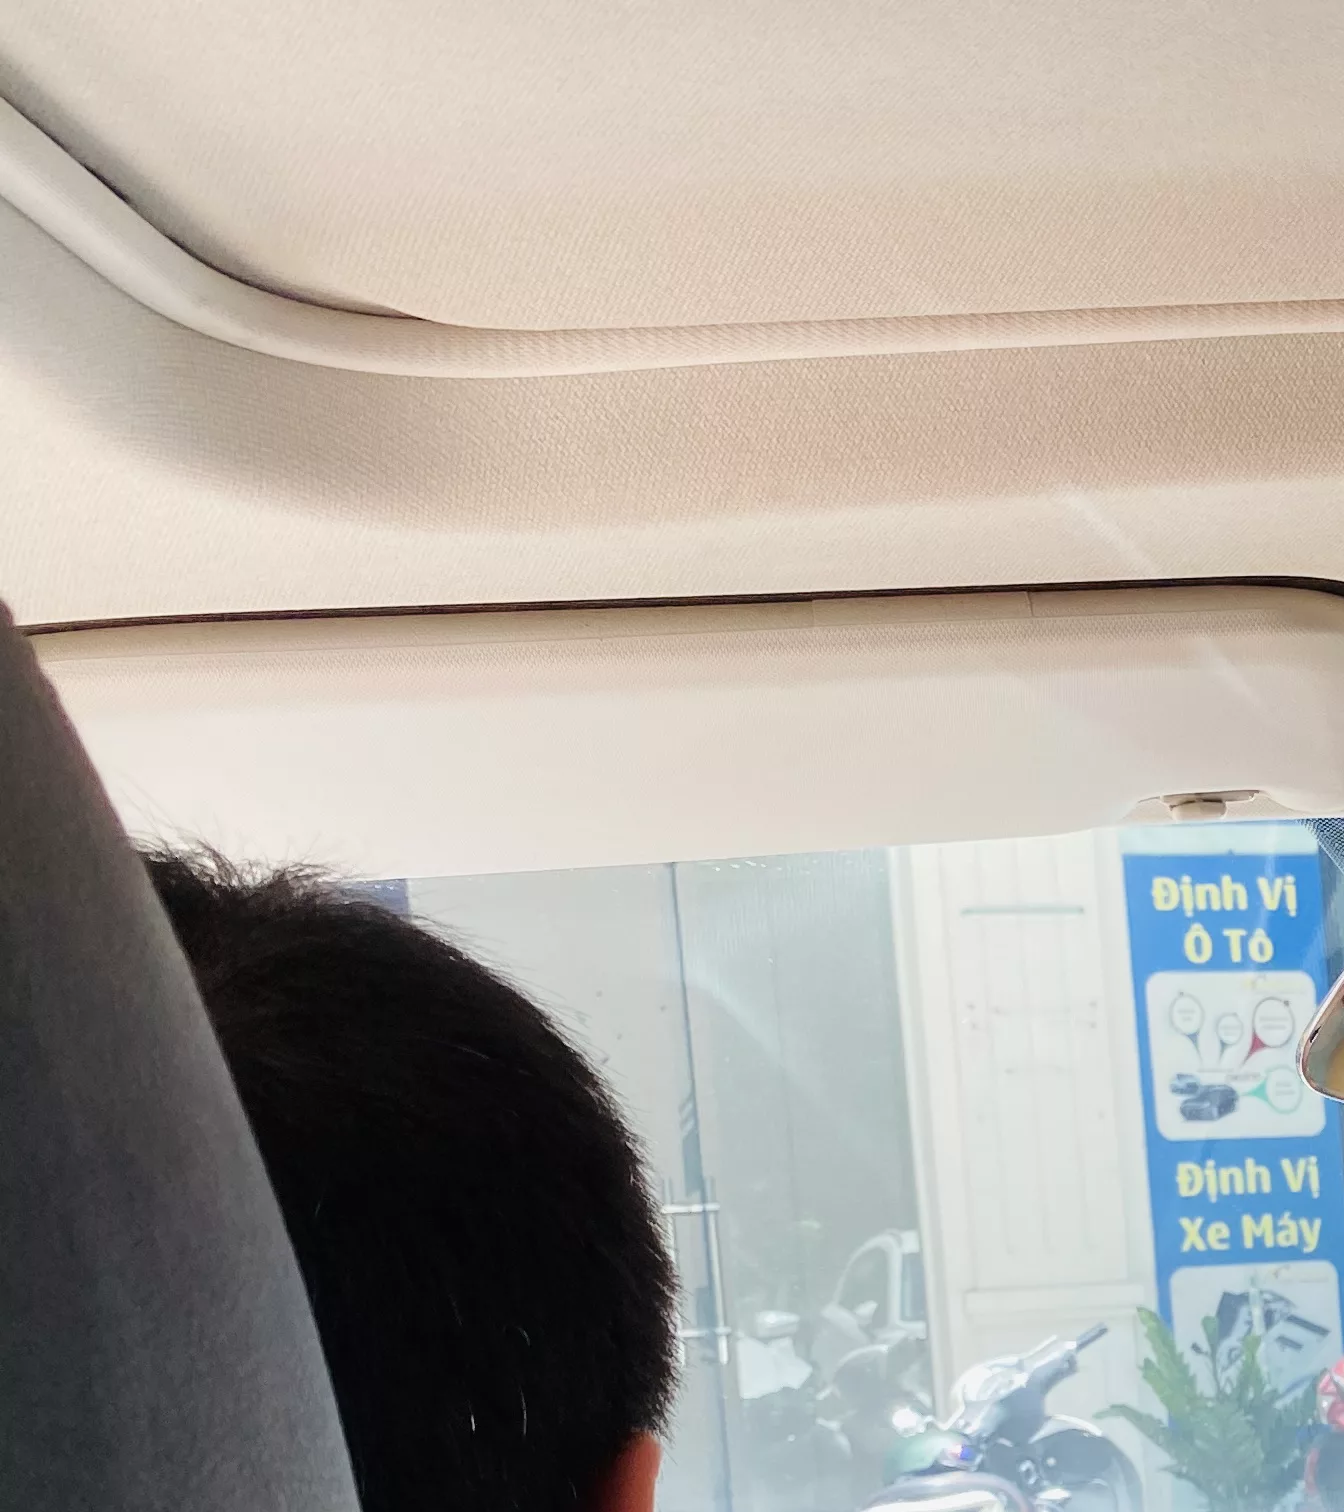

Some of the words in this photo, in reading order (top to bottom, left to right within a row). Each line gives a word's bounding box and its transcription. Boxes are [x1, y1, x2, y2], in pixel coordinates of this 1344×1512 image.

[1151, 874, 1248, 917] Định
[1257, 875, 1298, 917] Vị
[1184, 924, 1213, 964] Ô
[1223, 927, 1274, 964] Tô
[1176, 1158, 1271, 1202] Định
[1281, 1156, 1321, 1199] Vị
[1179, 1217, 1230, 1253] Xe
[1243, 1212, 1322, 1253] Máy
